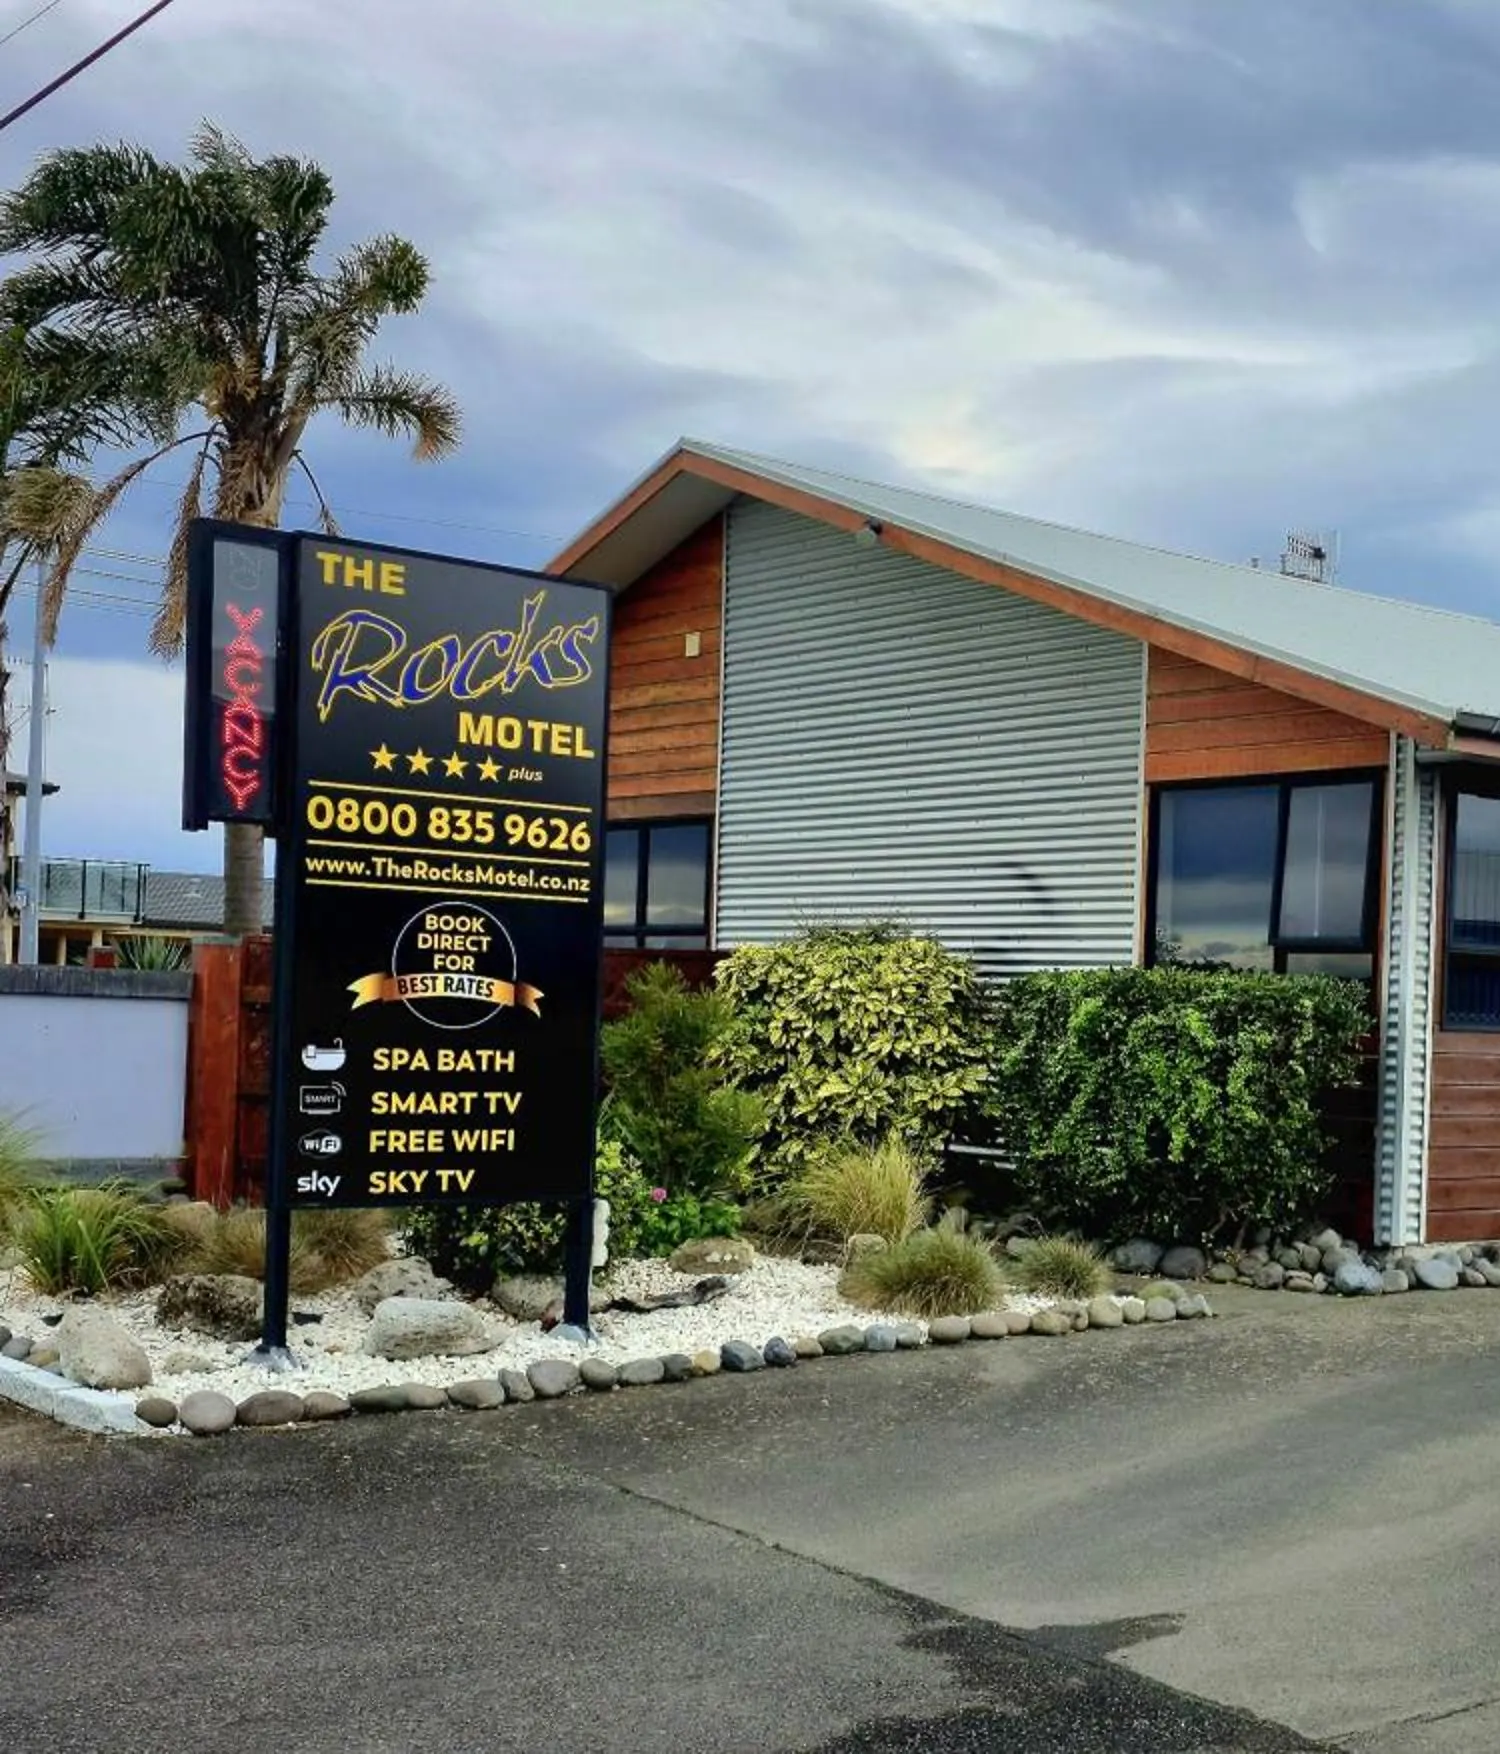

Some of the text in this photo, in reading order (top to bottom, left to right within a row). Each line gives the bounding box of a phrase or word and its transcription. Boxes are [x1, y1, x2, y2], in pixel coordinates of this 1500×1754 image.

[316, 551, 406, 595] THE
[311, 590, 599, 723] Rocks
[225, 601, 265, 814] VACANCY
[458, 711, 595, 758] MOTEL
[508, 766, 543, 784] plus
[306, 795, 591, 852] 0800 835 9626
[305, 856, 591, 892] www.TheRocksMotel.co.nz
[425, 914, 485, 933] BOOK
[417, 933, 492, 952] DIRECT
[433, 954, 475, 972] FOR
[398, 976, 495, 998] BEST RATES
[373, 1048, 515, 1073] SPA BATH
[371, 1092, 522, 1114] SMART TV
[369, 1129, 515, 1152] FREE WIFI
[297, 1171, 341, 1197] sky
[368, 1169, 476, 1193] SKY TV
